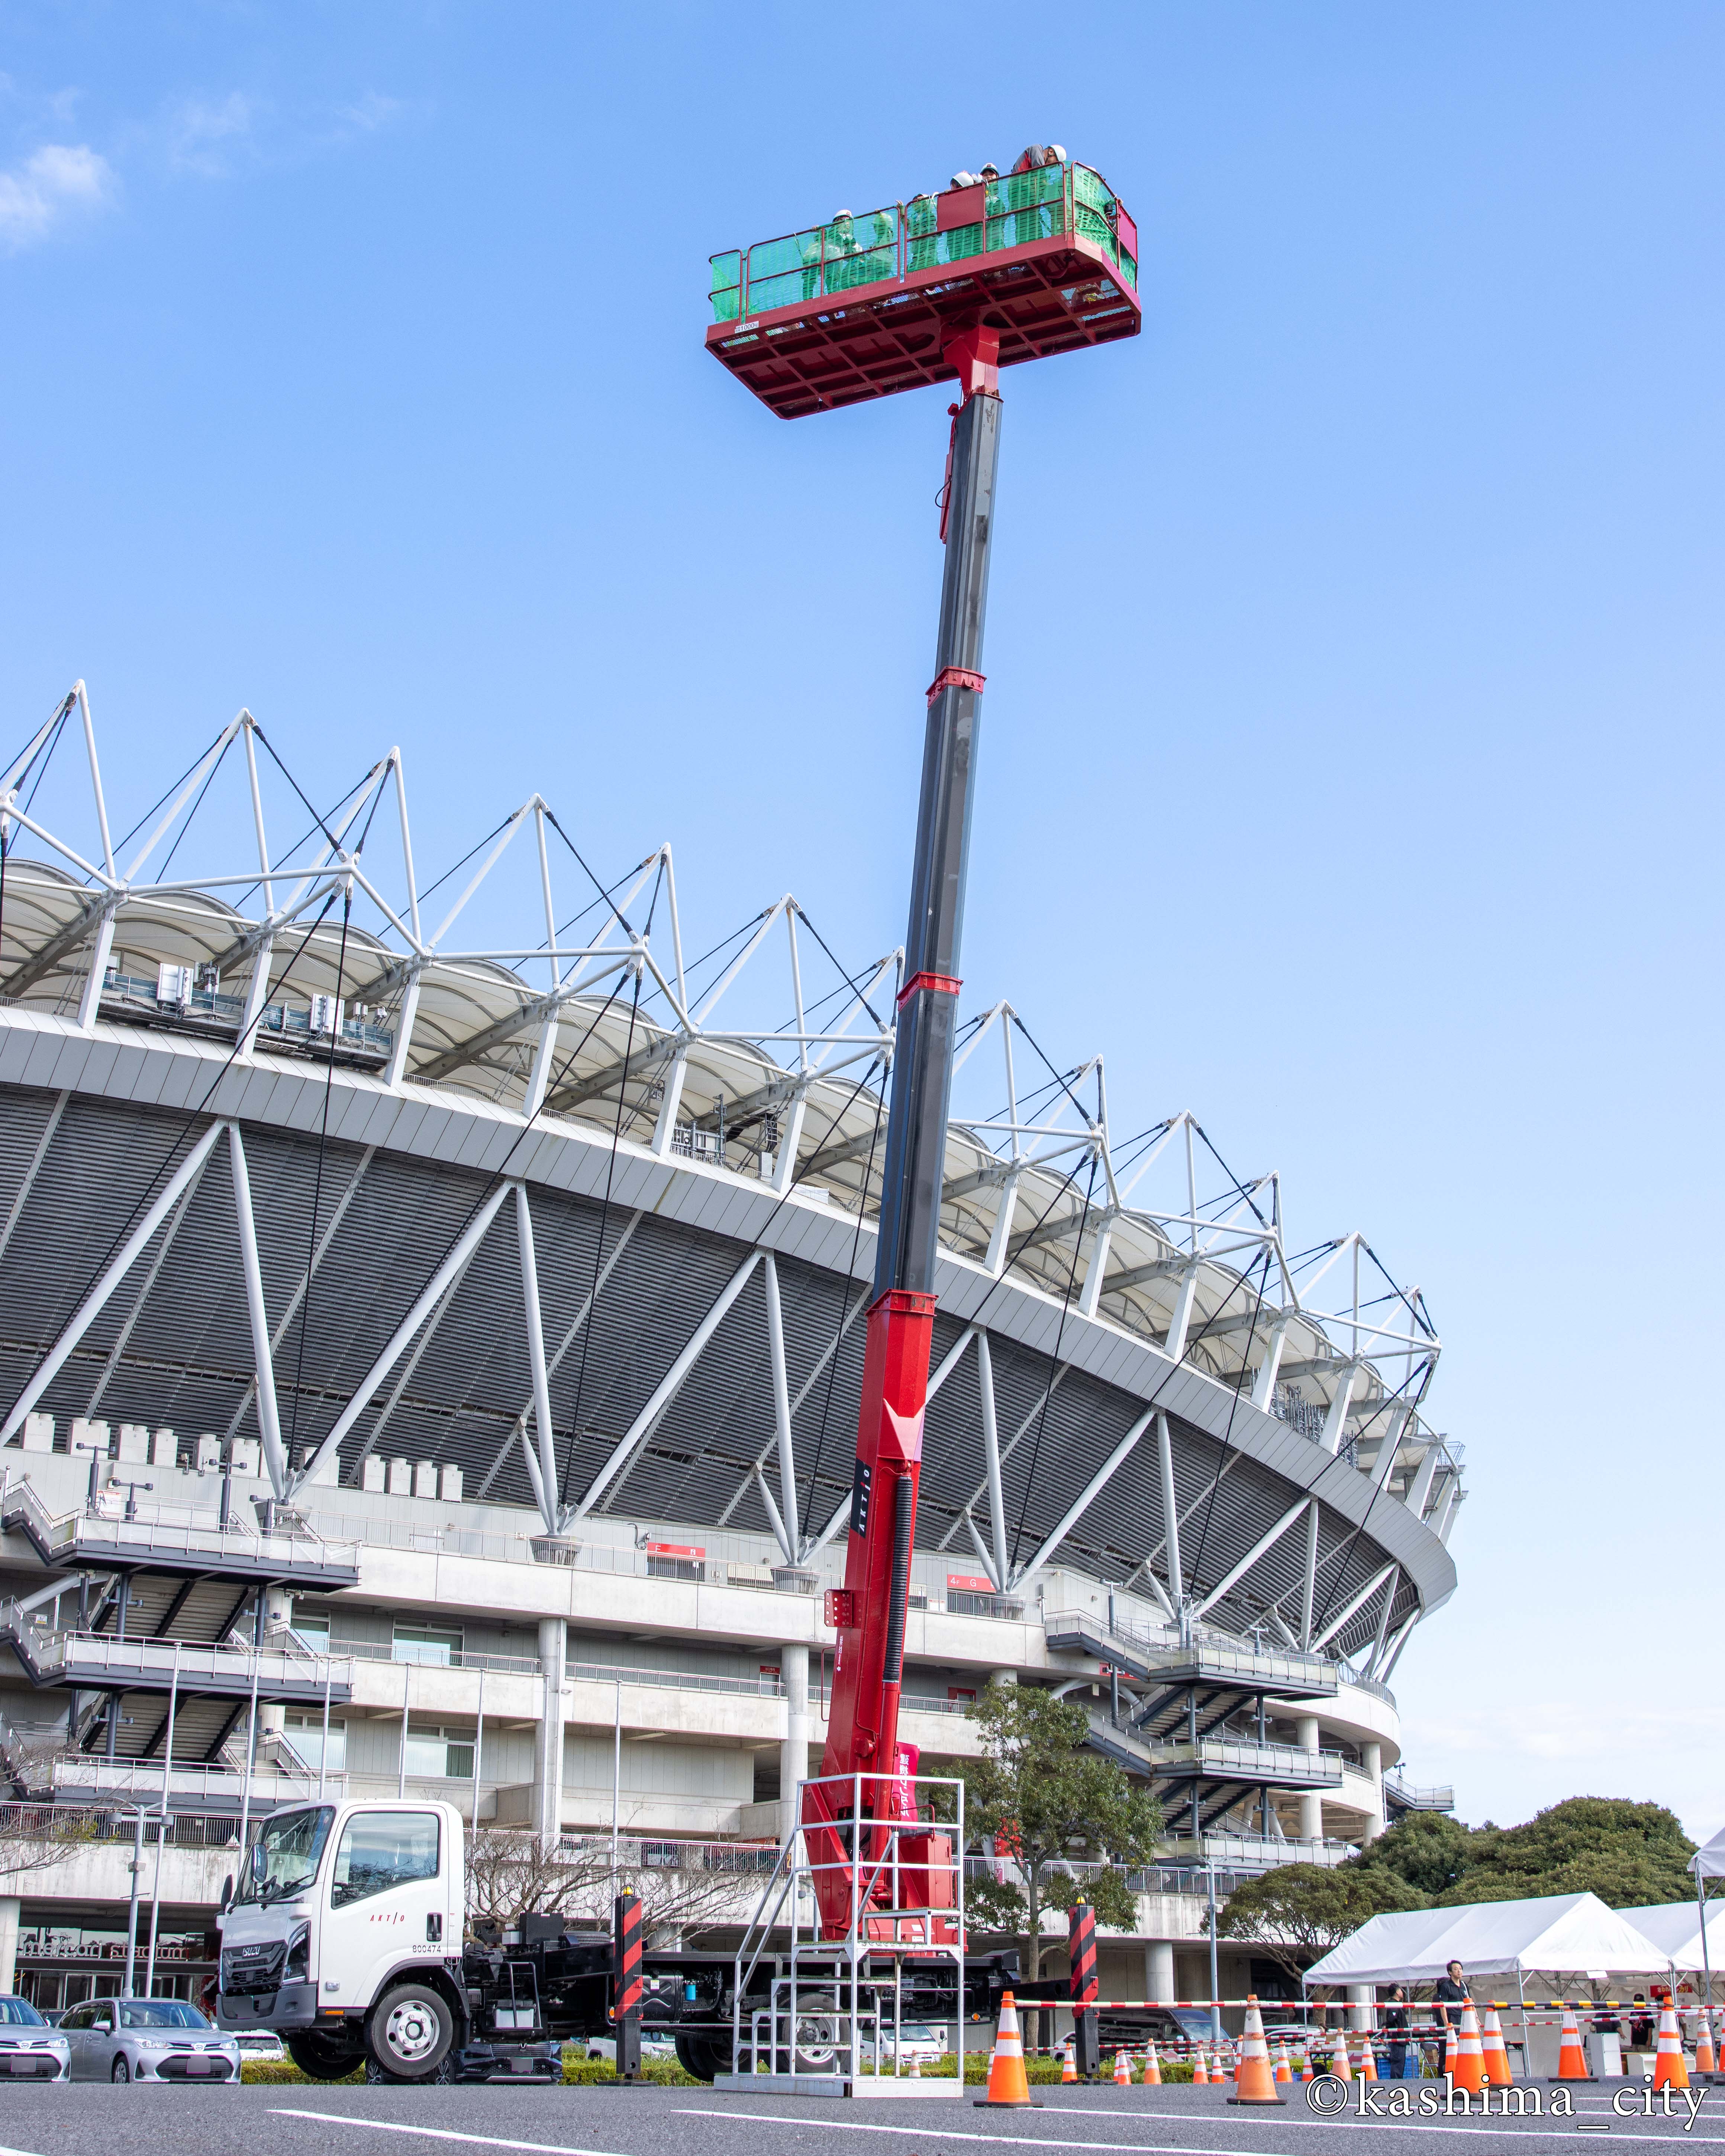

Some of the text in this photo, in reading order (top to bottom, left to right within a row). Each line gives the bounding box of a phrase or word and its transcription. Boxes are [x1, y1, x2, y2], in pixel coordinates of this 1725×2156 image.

[950, 1577, 977, 1587] 4F G
[23, 1940, 102, 1958] mercari
[242, 1946, 260, 1956] ISUZU
[412, 1945, 441, 1953] 800474
